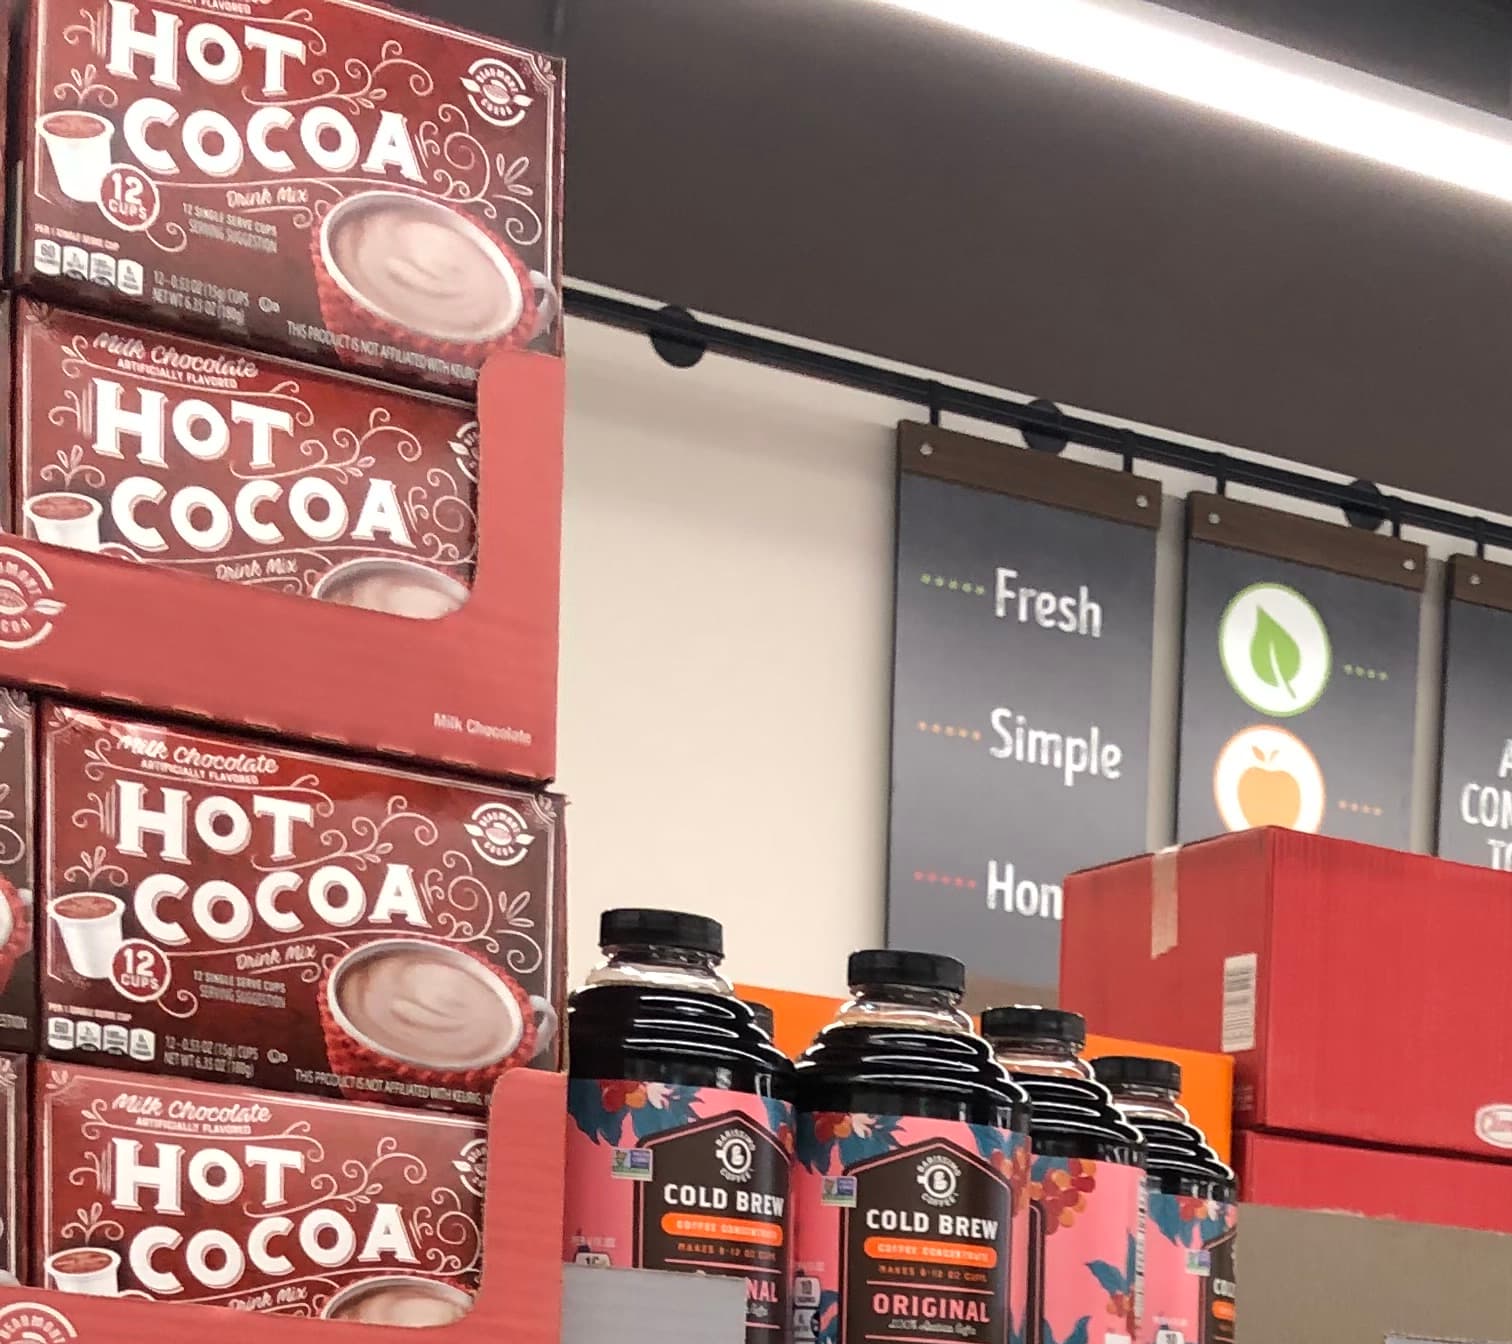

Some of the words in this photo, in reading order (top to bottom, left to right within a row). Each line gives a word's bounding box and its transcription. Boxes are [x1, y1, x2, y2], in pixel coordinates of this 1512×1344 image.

[107, 0, 307, 97] HOT
[123, 97, 426, 184] COCOA
[112, 172, 143, 204] 12
[108, 199, 147, 221] CUPS
[93, 333, 143, 359] Milk
[152, 344, 259, 381] Chocolate
[186, 369, 237, 389] FLAVORED
[91, 377, 295, 470] HOT
[111, 475, 416, 552] COCOA
[216, 560, 261, 581] Drink
[266, 559, 298, 577] Mix
[994, 567, 1102, 640] Fresh
[433, 712, 462, 732] Milk
[466, 716, 532, 746] Chocolate
[115, 734, 168, 760] Milk
[173, 746, 279, 775] Chocolate
[989, 707, 1123, 787] Simple
[115, 778, 314, 864] HOT
[134, 863, 431, 945] COCOA
[124, 948, 154, 976] 12
[236, 949, 281, 970] Drink
[285, 944, 317, 961] Mix
[120, 973, 159, 990] CUPS
[112, 1093, 162, 1120] Milk
[168, 1100, 272, 1124] Chocolate
[111, 1138, 305, 1217] HOT
[664, 1183, 728, 1210] COLD
[736, 1190, 784, 1217] BREW
[867, 1209, 929, 1232] COLD
[938, 1214, 998, 1240] BREW
[129, 1203, 421, 1294] COCOA
[277, 1286, 308, 1305] Mix
[873, 1293, 990, 1323] ORIGINAL
